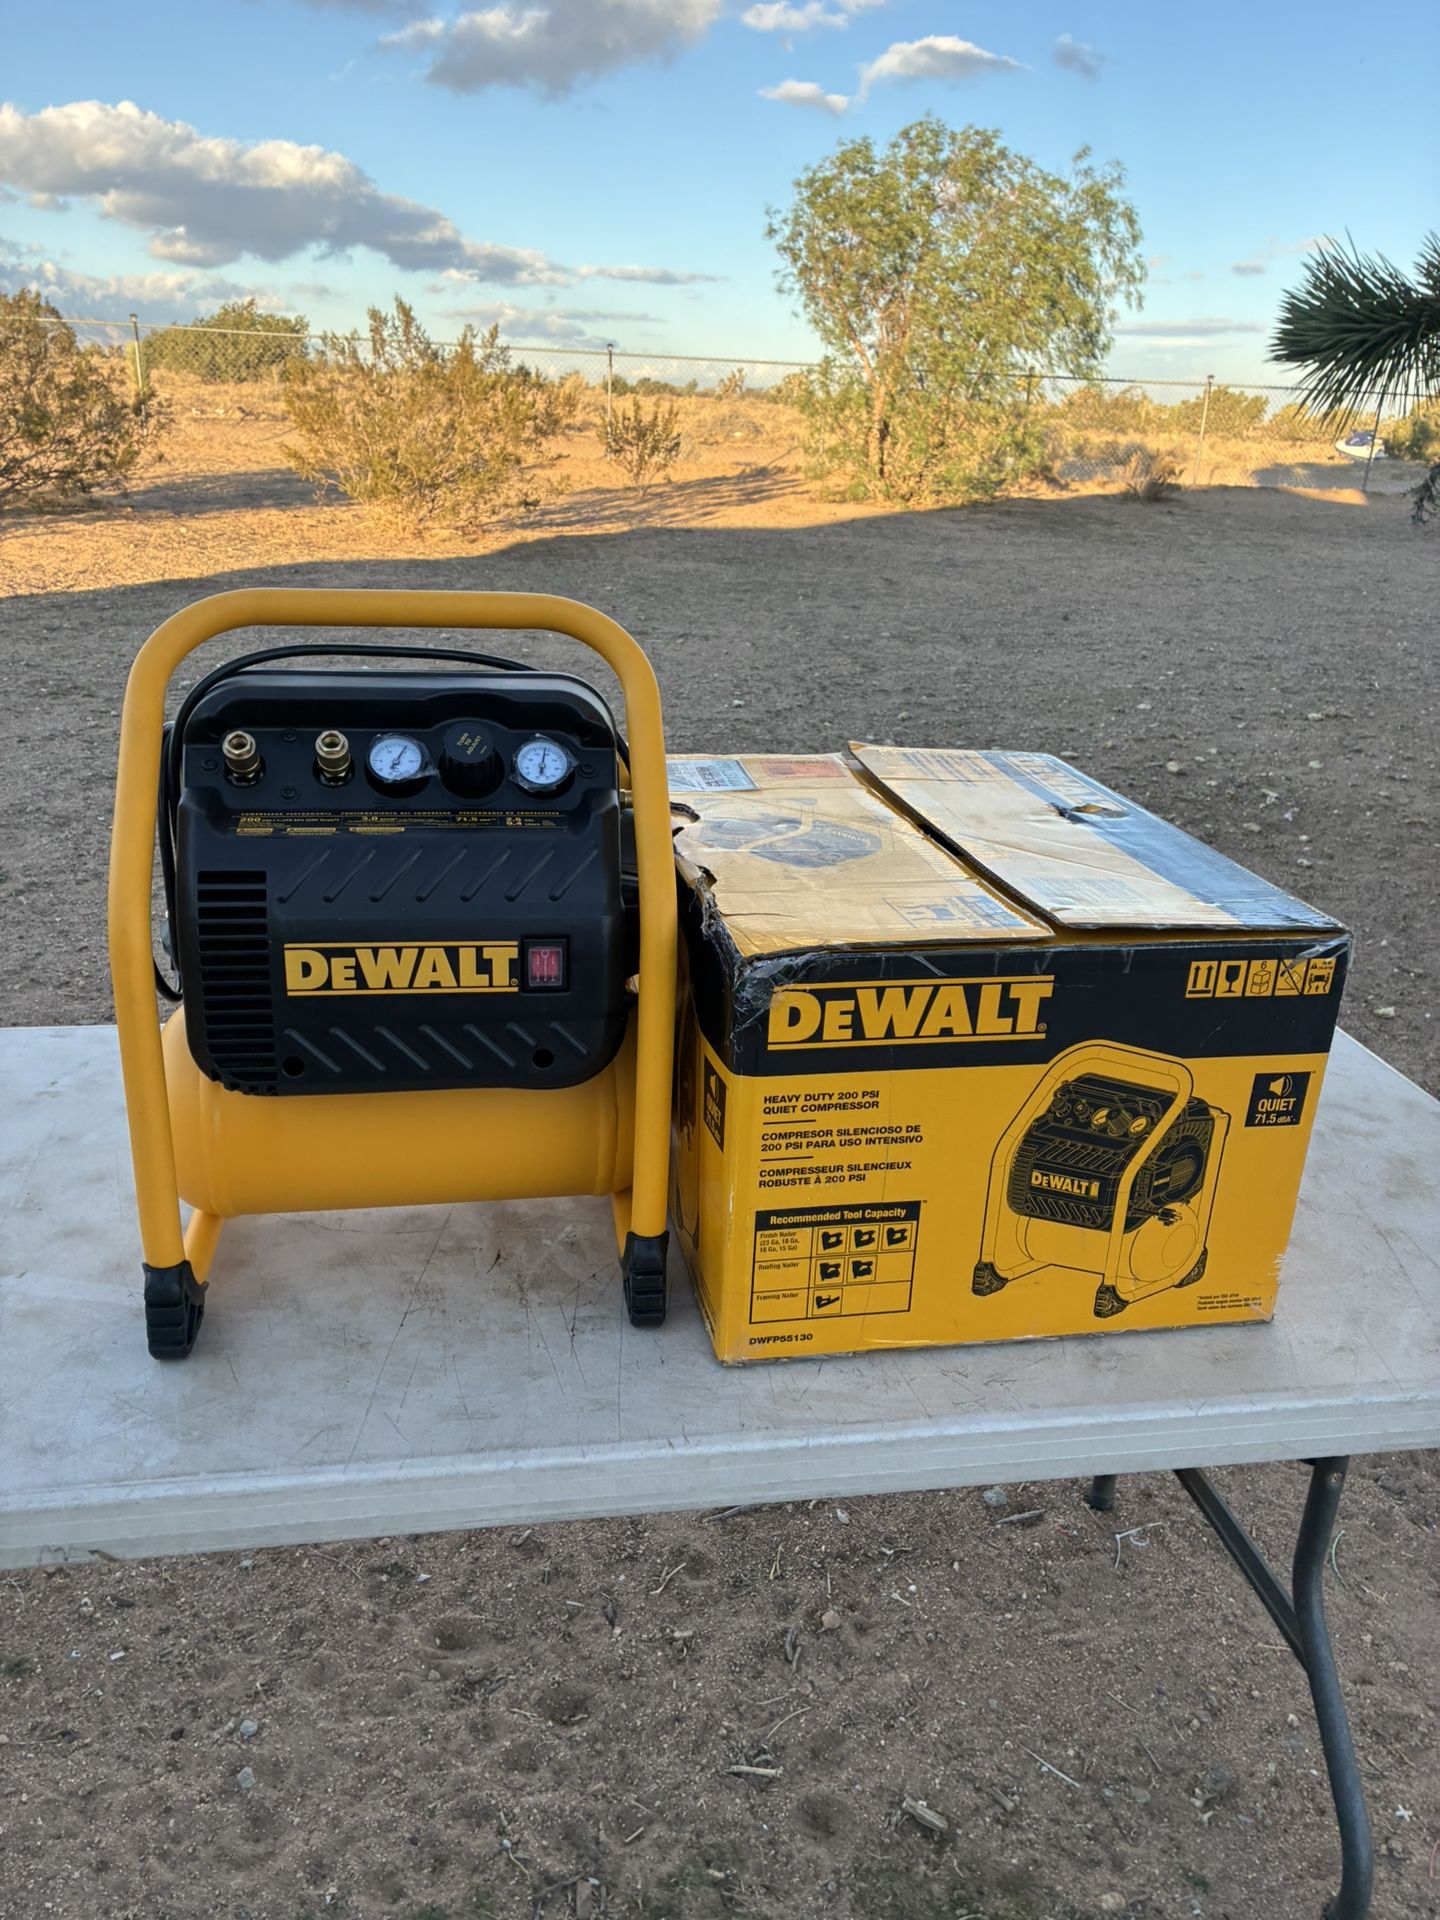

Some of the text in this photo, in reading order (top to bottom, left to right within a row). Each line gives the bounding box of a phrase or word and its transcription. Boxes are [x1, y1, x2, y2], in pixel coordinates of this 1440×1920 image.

[764, 1090, 879, 1104] HEAVY DUTY 200 PSI
[763, 1101, 879, 1115] QUIET COMPRESSOR
[1258, 1098, 1296, 1112] QUIET
[1254, 1113, 1276, 1124] 71.5
[762, 1125, 921, 1141] COMPRESOR SILENCIOSO DE
[761, 1135, 923, 1151] 200 PSI PARA USO INTENSIVO
[760, 1161, 912, 1178] COMPRESSEUR SILENCIEUX
[759, 1174, 866, 1188] ROBUSTE À 200 PSI
[770, 1208, 907, 1225] Recommended Tool Capacity
[749, 1333, 813, 1345] DWFP55130
